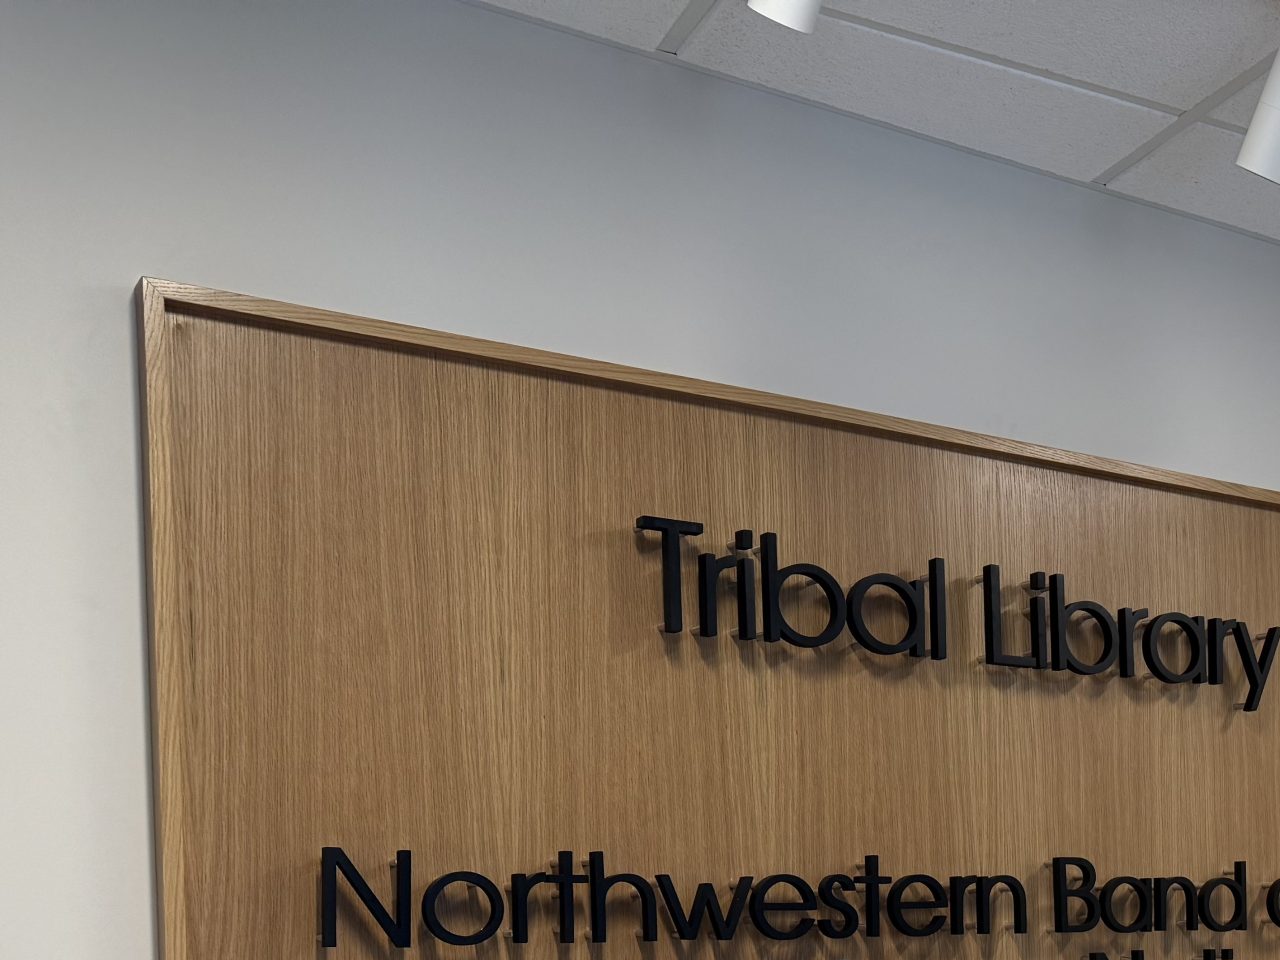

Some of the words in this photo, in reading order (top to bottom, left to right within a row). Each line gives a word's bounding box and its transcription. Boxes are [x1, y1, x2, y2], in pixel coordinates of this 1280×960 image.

[635, 515, 947, 660] Tribal
[320, 846, 1028, 949] Northwestern
[1051, 856, 1248, 934] Band
